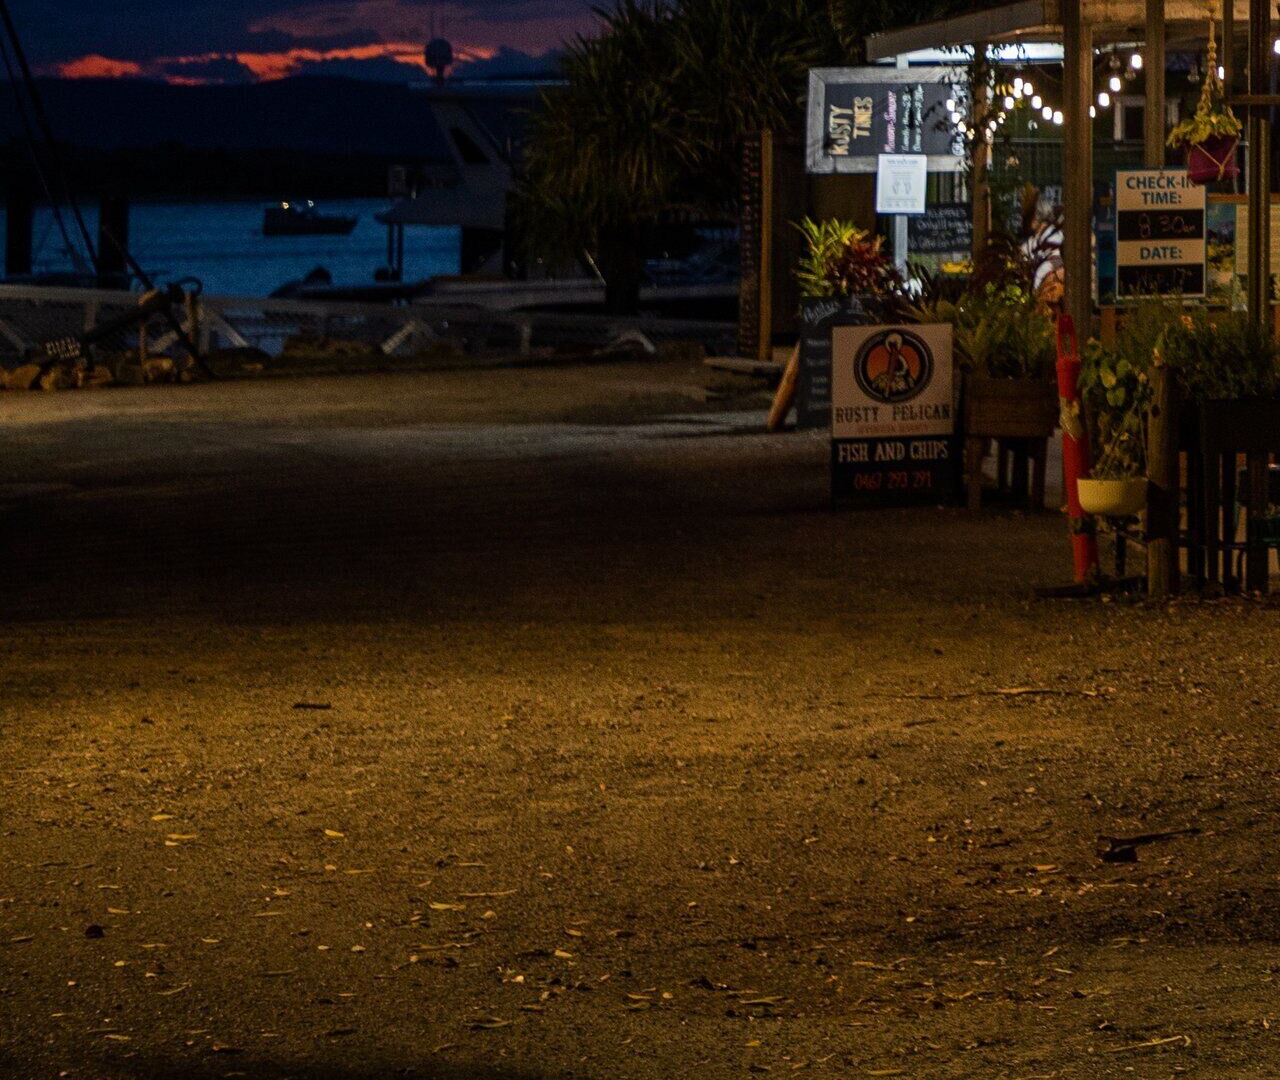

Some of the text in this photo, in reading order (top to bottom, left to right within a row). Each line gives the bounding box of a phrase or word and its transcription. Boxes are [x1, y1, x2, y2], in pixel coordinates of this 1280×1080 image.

[1142, 191, 1182, 204] TIME:
[1140, 246, 1182, 259] DATE:
[835, 404, 951, 423] RUSTY PELICAN
[837, 439, 949, 463] FISH AND CHIPS
